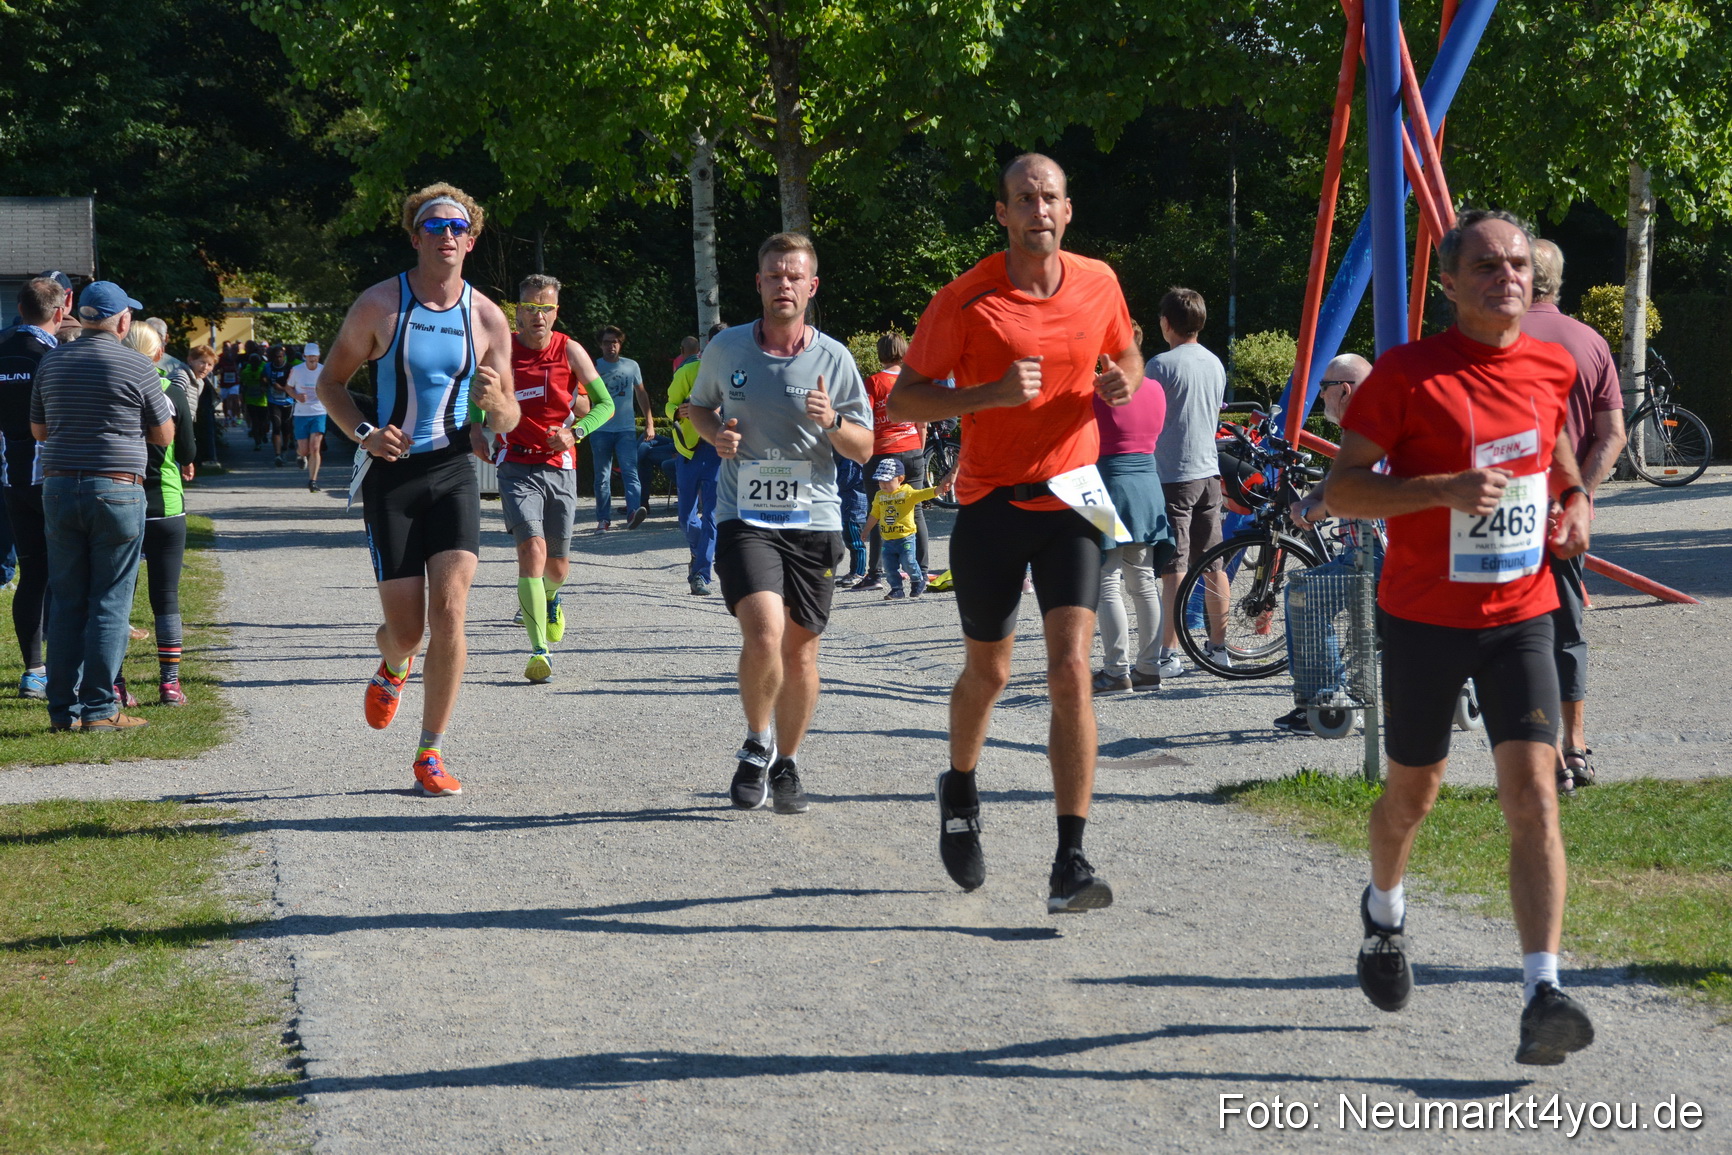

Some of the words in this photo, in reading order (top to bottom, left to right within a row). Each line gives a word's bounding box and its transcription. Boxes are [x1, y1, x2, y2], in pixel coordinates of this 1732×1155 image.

[1492, 441, 1521, 457] DEHN
[760, 466, 792, 475] BOCK
[749, 479, 798, 501] 2131
[760, 512, 791, 522] Dennis
[1468, 503, 1536, 538] 2463
[1481, 553, 1526, 570] Edmund
